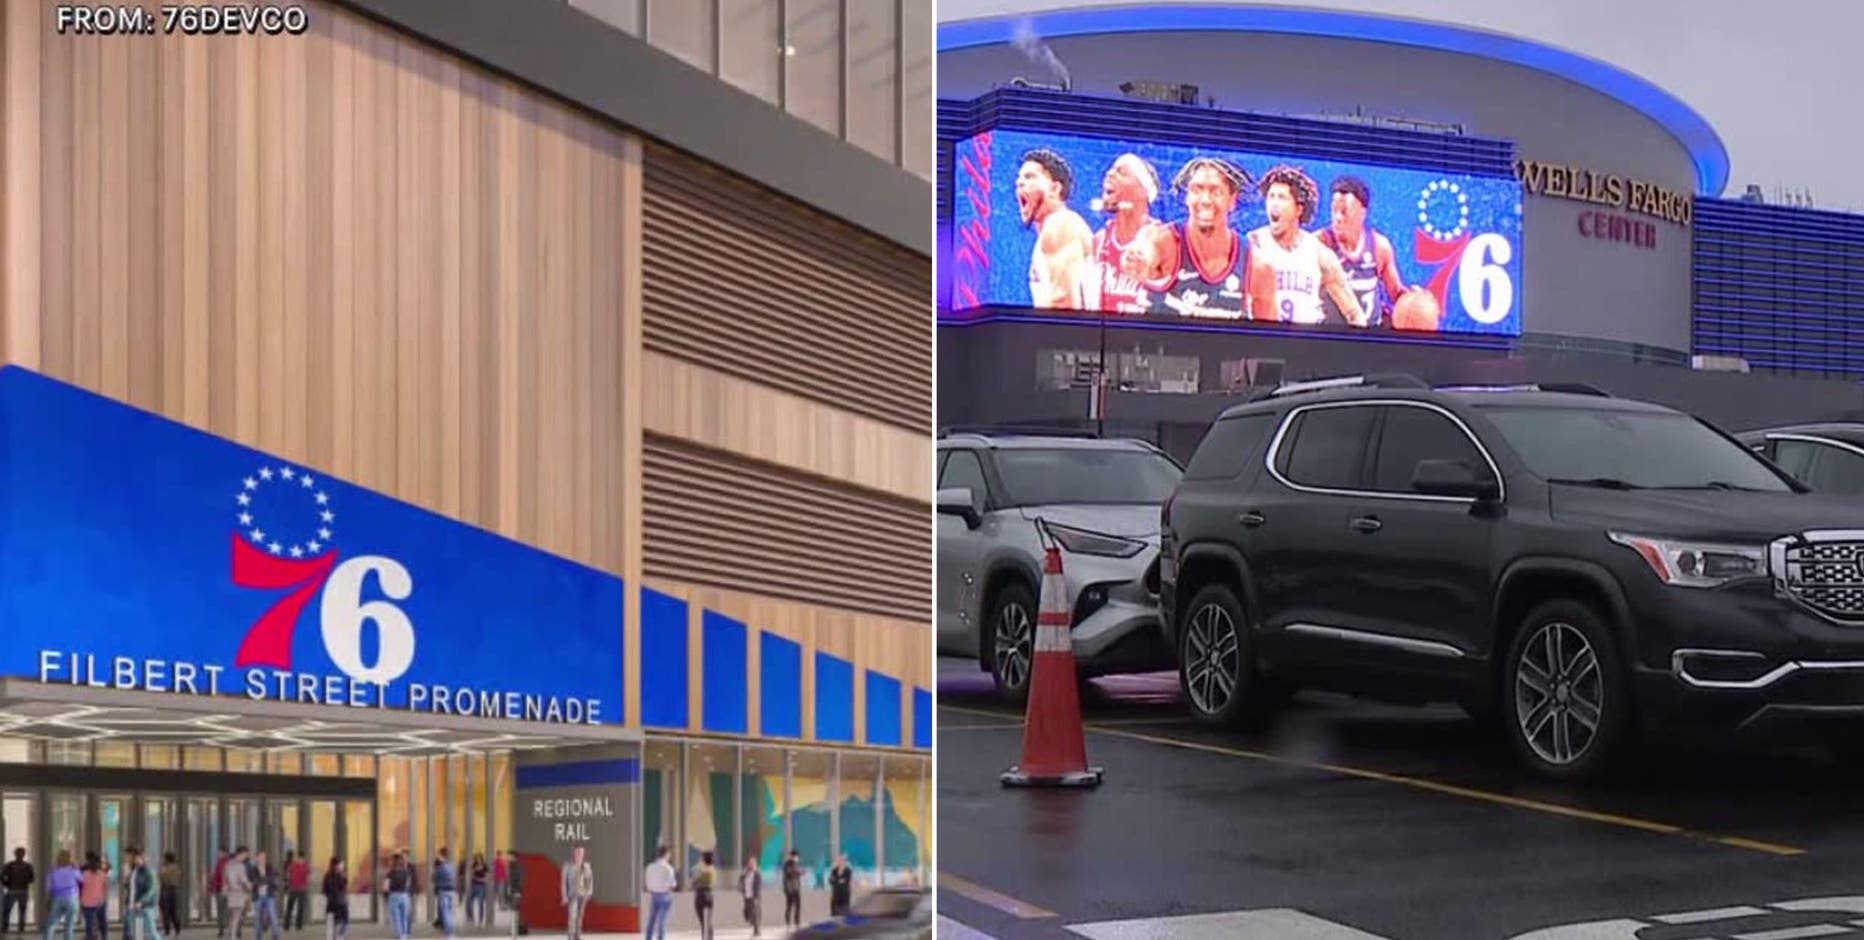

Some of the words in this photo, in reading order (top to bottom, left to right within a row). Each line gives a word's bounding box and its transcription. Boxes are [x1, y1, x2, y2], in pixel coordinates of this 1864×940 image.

[1513, 160, 1623, 207] WELLS
[1629, 179, 1692, 225] FARGO
[1578, 210, 1656, 249] CENTER
[1415, 226, 1513, 324] 76
[231, 531, 416, 686] 76
[40, 650, 224, 697] FILBERT
[246, 667, 390, 710] STREET
[410, 683, 602, 726] PROMENADE
[533, 797, 614, 818] REGIONAL
[554, 822, 590, 842] RAIL
